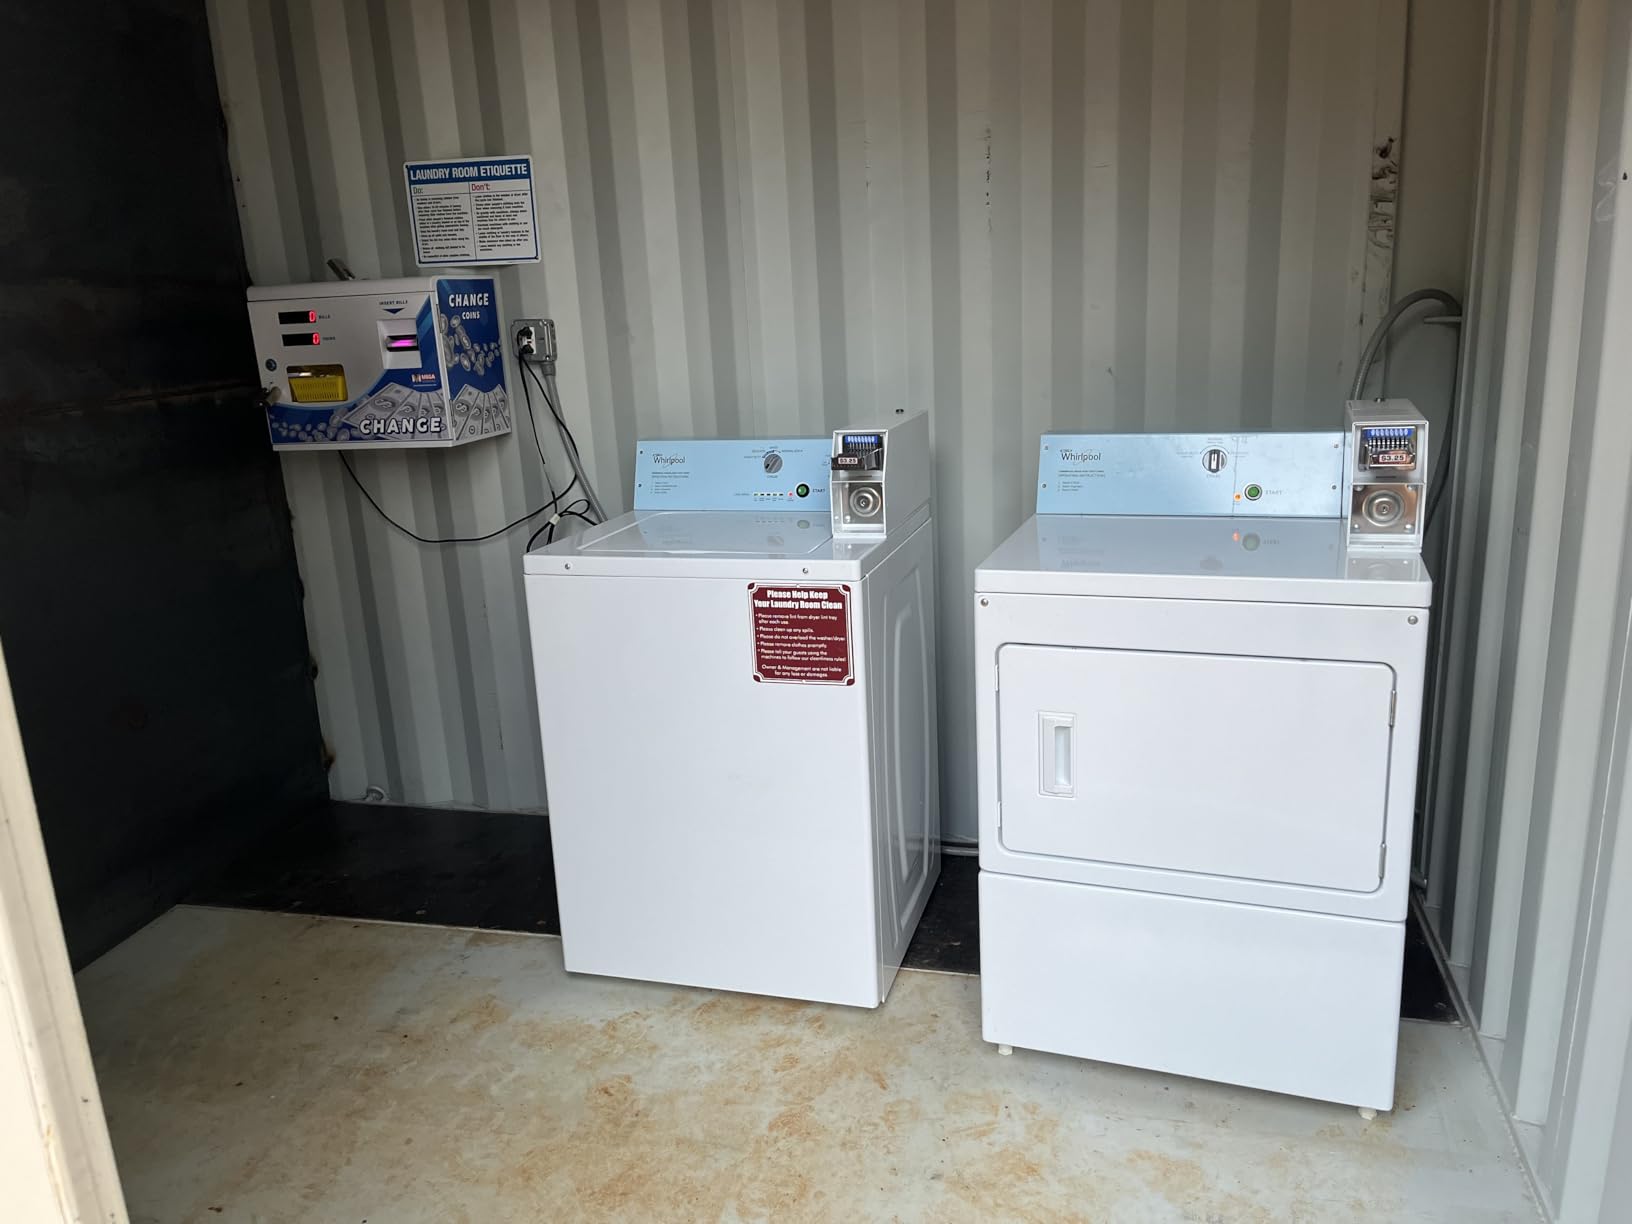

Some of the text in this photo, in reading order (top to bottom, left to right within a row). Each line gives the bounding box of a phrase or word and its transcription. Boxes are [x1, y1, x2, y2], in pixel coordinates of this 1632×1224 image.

[410, 163, 527, 181] LAUNDRY ROOM ETIQUETTE
[448, 293, 489, 307] CHANGE
[309, 310, 316, 322] 0
[462, 311, 480, 320] COINS
[313, 333, 319, 344] 0
[360, 417, 441, 434] CHANGE
[654, 456, 685, 466] Whirlpool
[1061, 452, 1101, 462] Whirlpool
[766, 590, 828, 600] Please Help Keep
[754, 599, 842, 609] Your Laundry Room Clean
